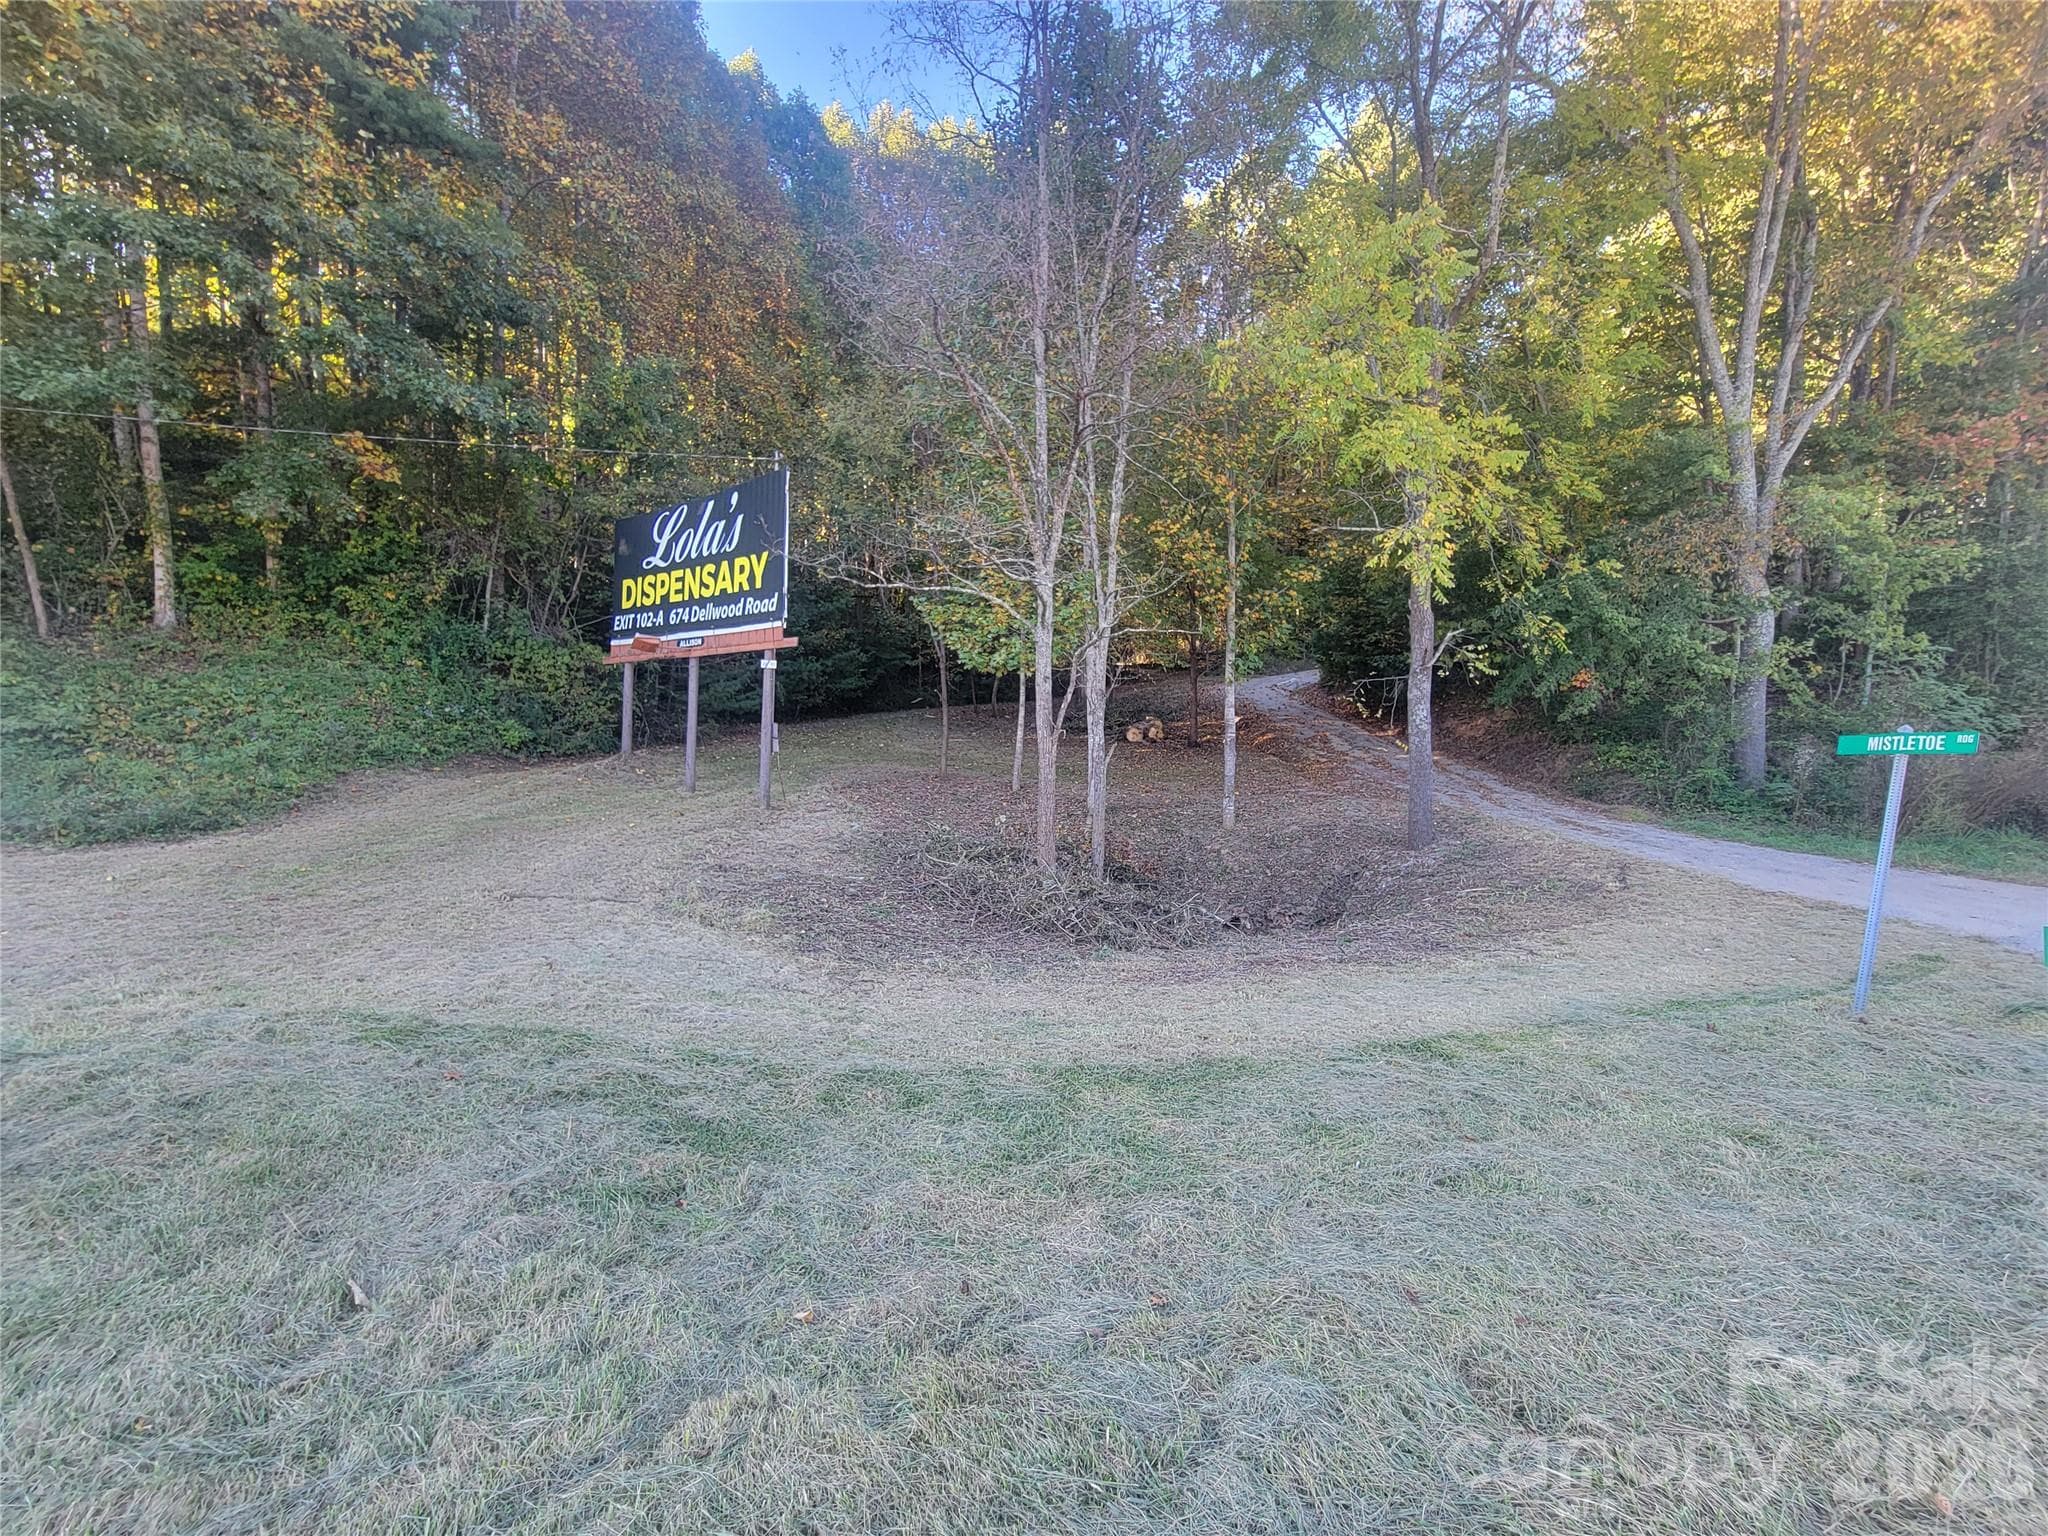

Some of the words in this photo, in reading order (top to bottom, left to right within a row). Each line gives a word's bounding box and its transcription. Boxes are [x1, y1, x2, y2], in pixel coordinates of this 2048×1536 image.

[643, 491, 744, 570] Lola's
[621, 551, 769, 609] DISPENSARY
[614, 614, 636, 631] EXIT
[636, 609, 663, 629] 102-A
[669, 606, 689, 625] 674
[691, 597, 743, 622] Dellwood
[745, 592, 778, 614] Road
[679, 638, 702, 647] ALLISON
[1867, 735, 1946, 751] MISTLETOE
[1957, 734, 1974, 743] RDG
